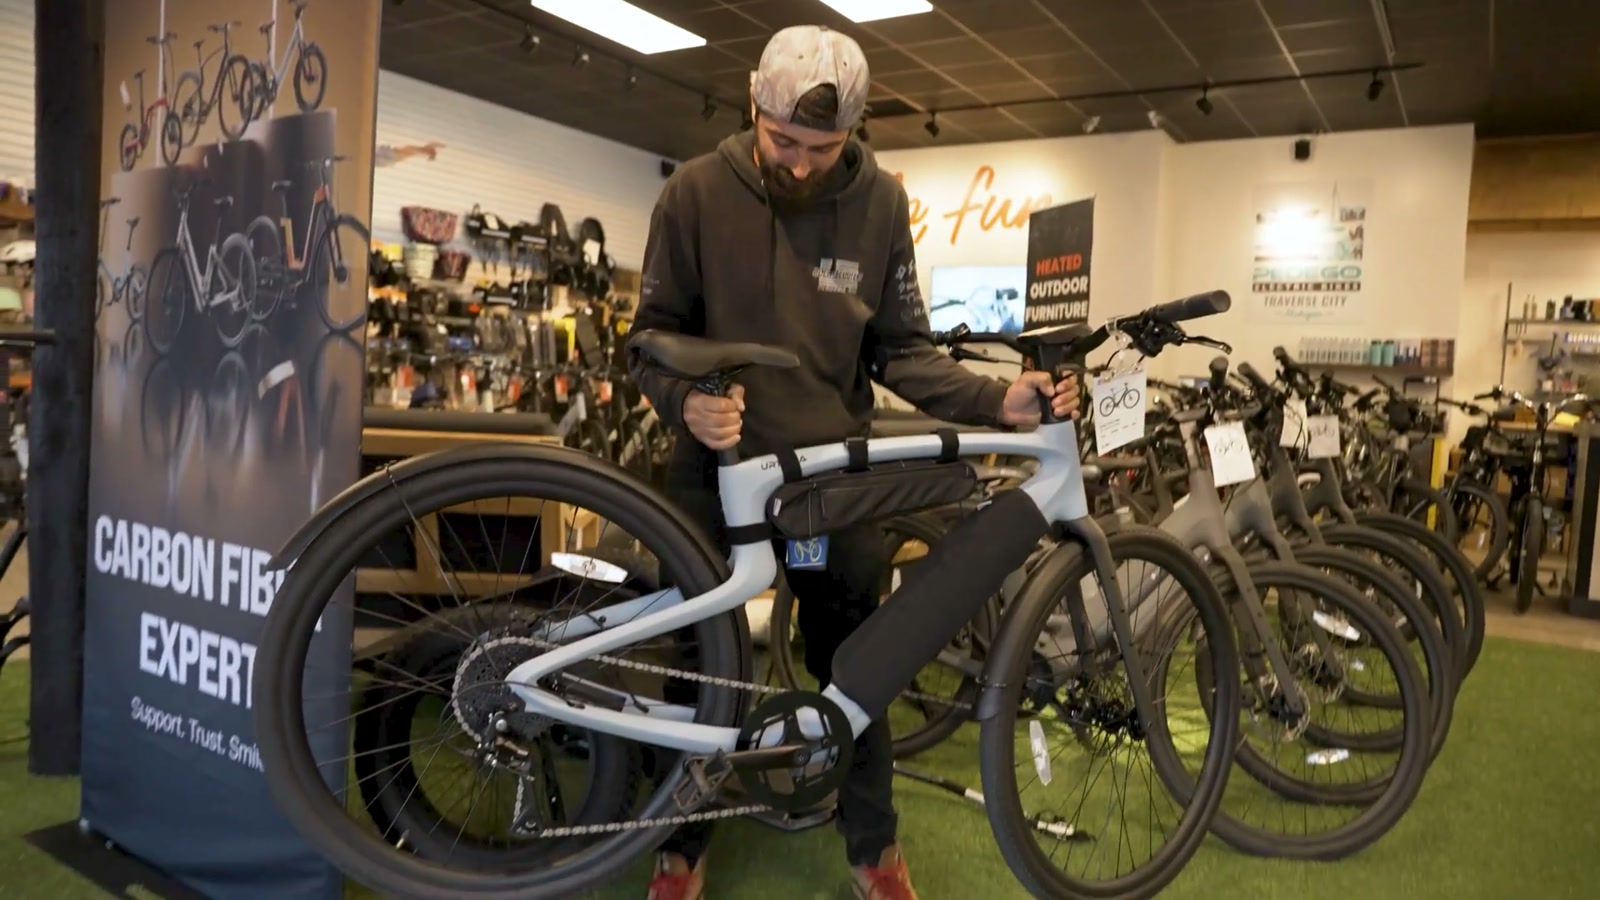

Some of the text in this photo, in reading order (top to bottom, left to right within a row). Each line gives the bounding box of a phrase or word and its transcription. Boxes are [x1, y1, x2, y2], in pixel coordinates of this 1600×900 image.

[1036, 253, 1082, 276] HEATED
[1030, 275, 1088, 299] OUTDOOR
[1025, 300, 1088, 322] FURNITURE
[1264, 295, 1347, 308] TRAVERSE CITY
[94, 514, 299, 618] CARBON FIB
